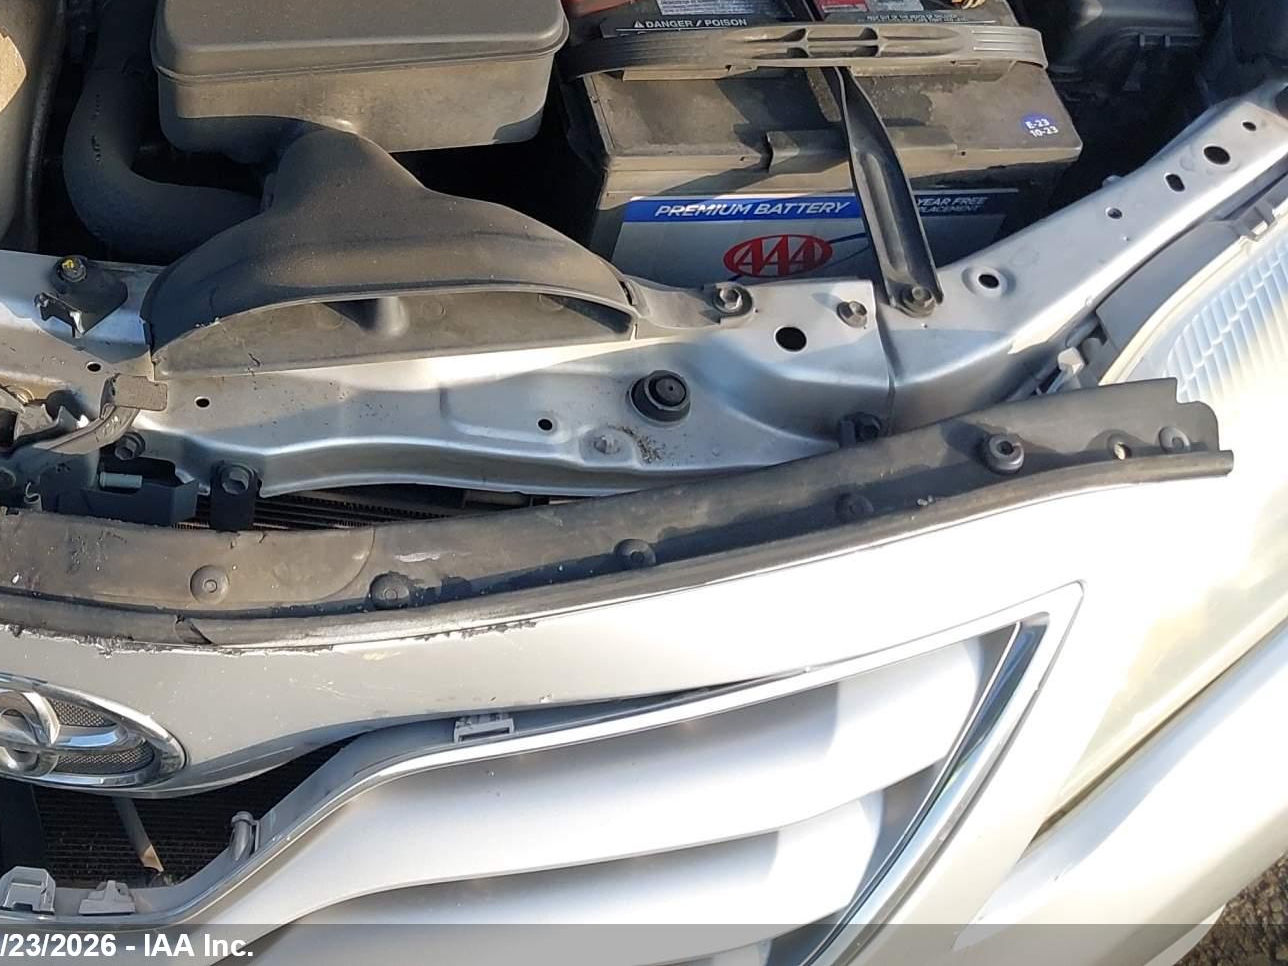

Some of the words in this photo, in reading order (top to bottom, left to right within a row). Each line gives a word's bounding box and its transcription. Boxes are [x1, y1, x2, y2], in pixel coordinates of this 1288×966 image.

[645, 19, 693, 28] DANGER
[705, 18, 748, 27] POISON
[1025, 118, 1050, 129] E-23
[1029, 125, 1059, 137] 10-23
[918, 198, 952, 206] YEAR
[951, 197, 988, 205] FREE
[655, 203, 753, 217] PREMIUM
[753, 201, 850, 215] BATTERY
[732, 234, 823, 276] AAA
